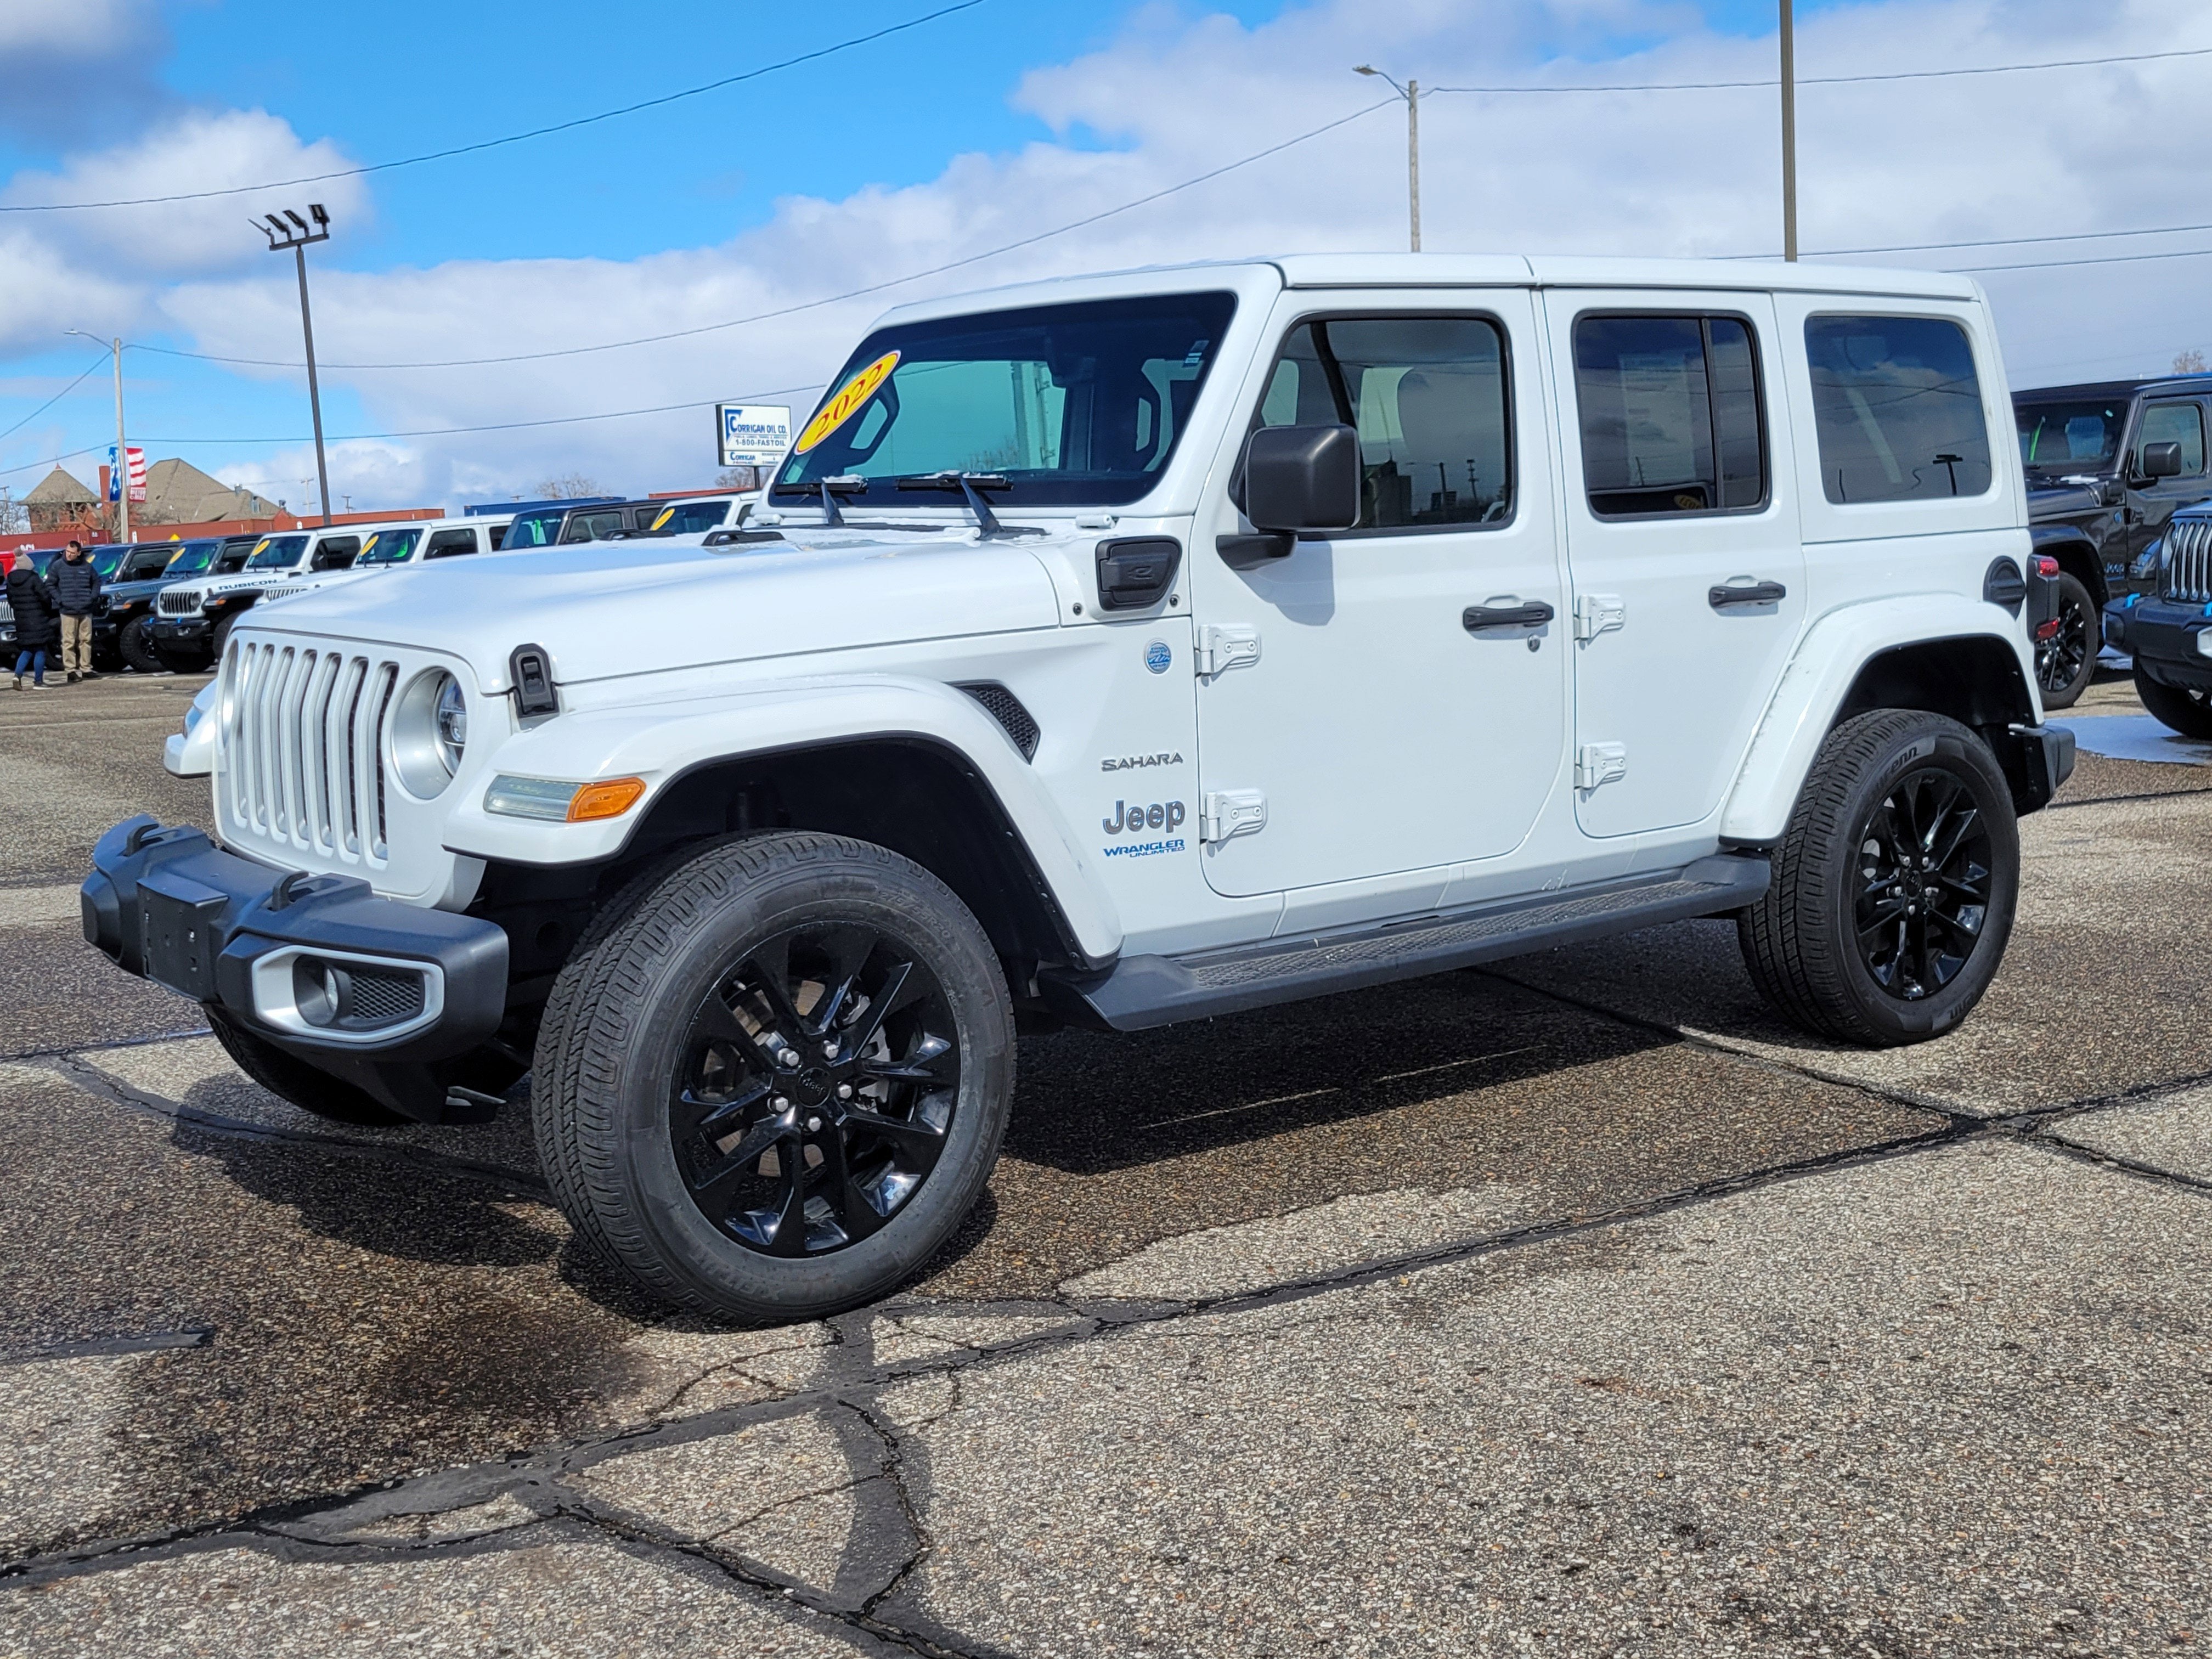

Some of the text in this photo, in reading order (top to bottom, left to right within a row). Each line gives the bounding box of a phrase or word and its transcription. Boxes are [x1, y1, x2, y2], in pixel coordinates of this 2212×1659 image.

[814, 363, 883, 442] 2022
[730, 416, 787, 434] CORRIGAN OIL CO.
[218, 579, 277, 590] RUBICON
[1101, 752, 1183, 772] SAHARA
[1102, 800, 1186, 835] Jeep
[1103, 839, 1184, 857] WRANGLER
[1129, 846, 1185, 858] UNLIMITED
